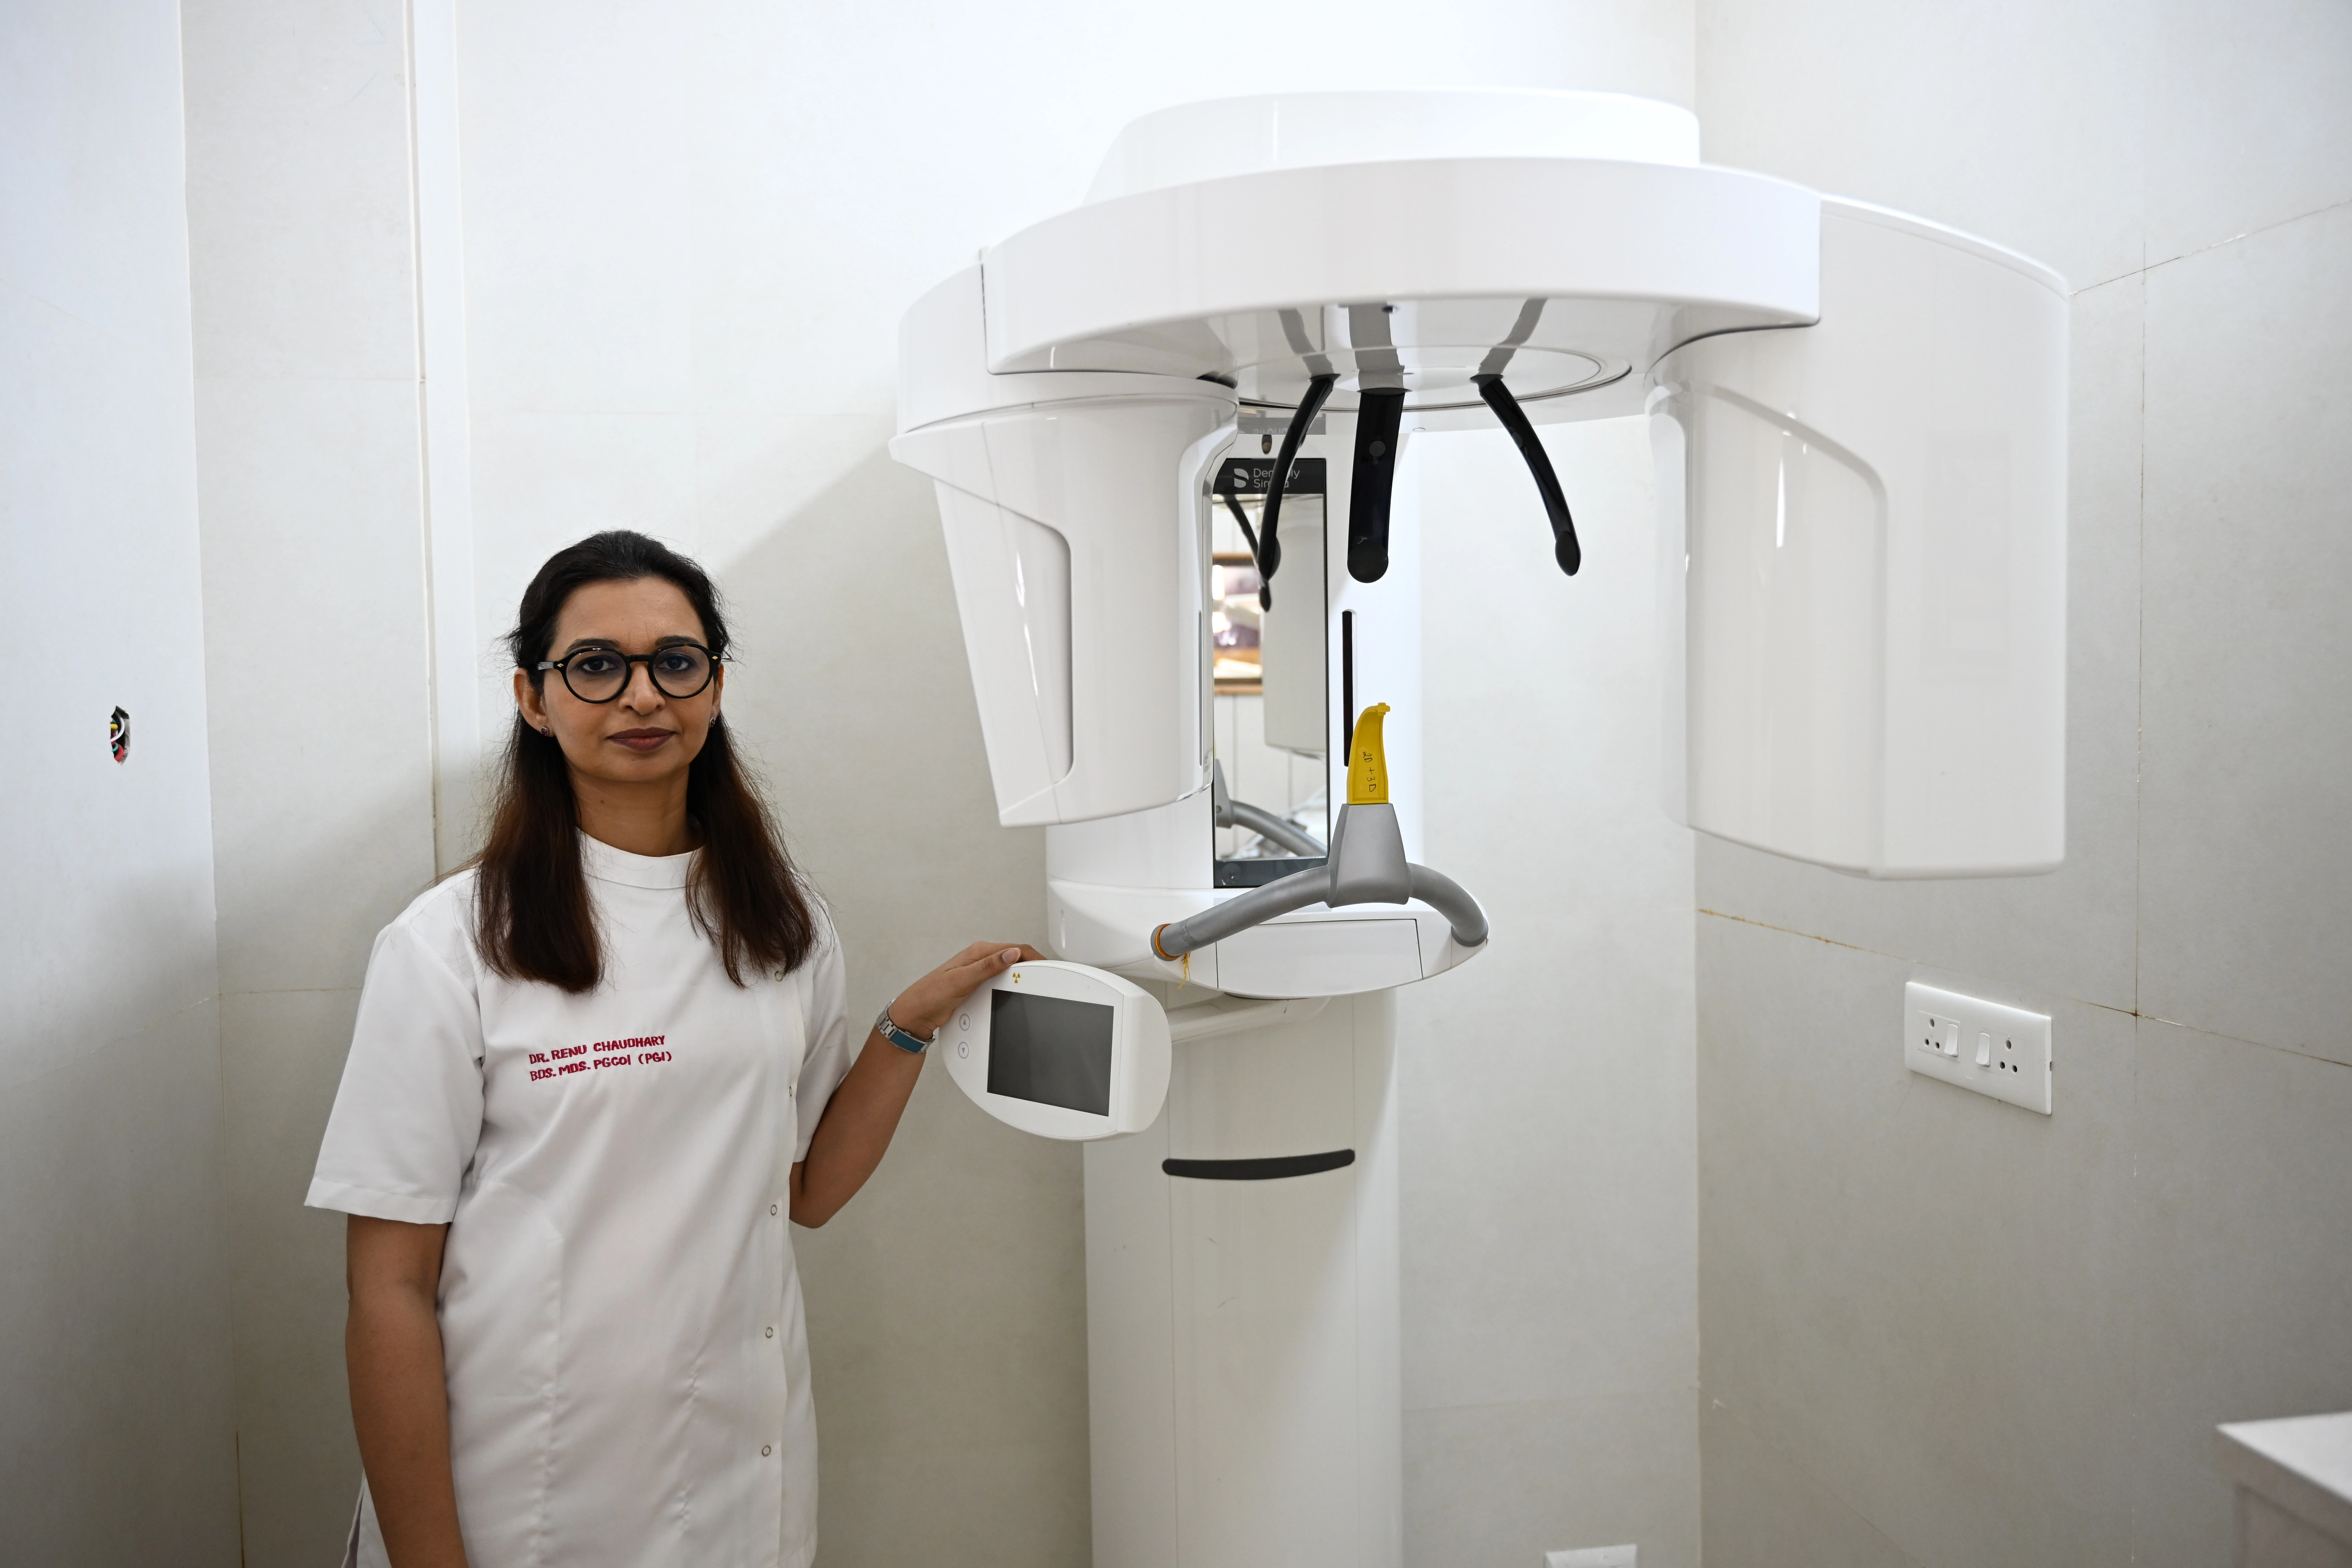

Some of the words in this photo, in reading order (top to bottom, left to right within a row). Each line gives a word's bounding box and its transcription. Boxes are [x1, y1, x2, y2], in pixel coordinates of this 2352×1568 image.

[1253, 468, 1300, 479] Denly
[1254, 479, 1289, 488] Sira
[1362, 751, 1373, 763] 2D
[529, 1053, 550, 1064] DR.
[551, 1045, 587, 1060] RENU
[593, 1035, 665, 1052] CHAUDHARY
[530, 1068, 556, 1082] BDS.
[558, 1060, 591, 1075] MDS.
[638, 1051, 672, 1064] (PGI)
